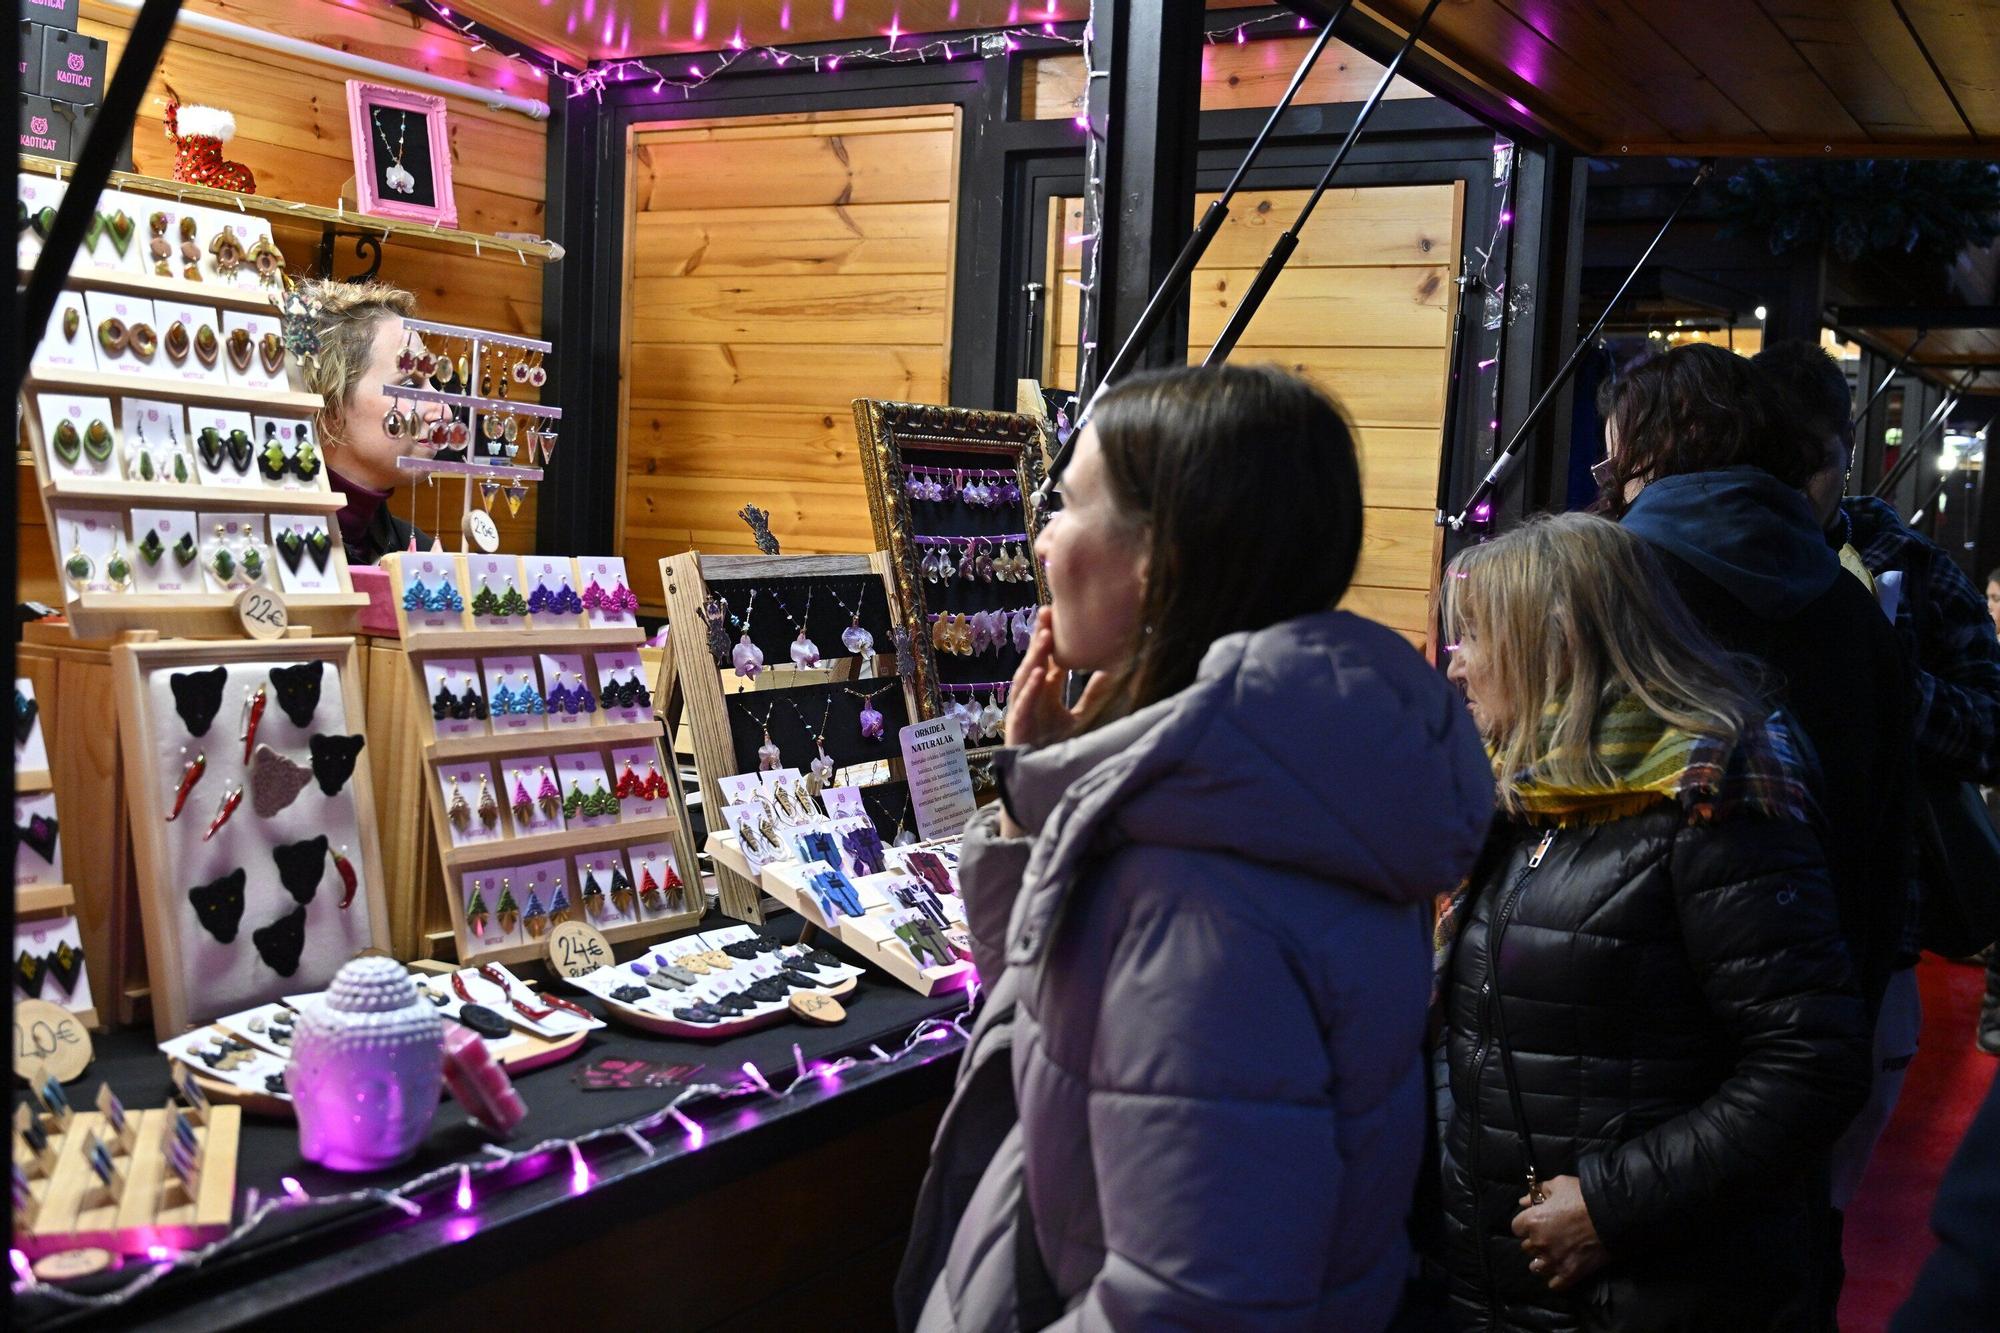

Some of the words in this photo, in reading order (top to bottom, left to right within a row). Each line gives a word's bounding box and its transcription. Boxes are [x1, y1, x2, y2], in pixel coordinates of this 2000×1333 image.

[245, 594, 284, 627] 22€
[914, 723, 946, 739] ORKIDEA
[911, 734, 955, 754] NATURALAK
[558, 935, 604, 966] 24€
